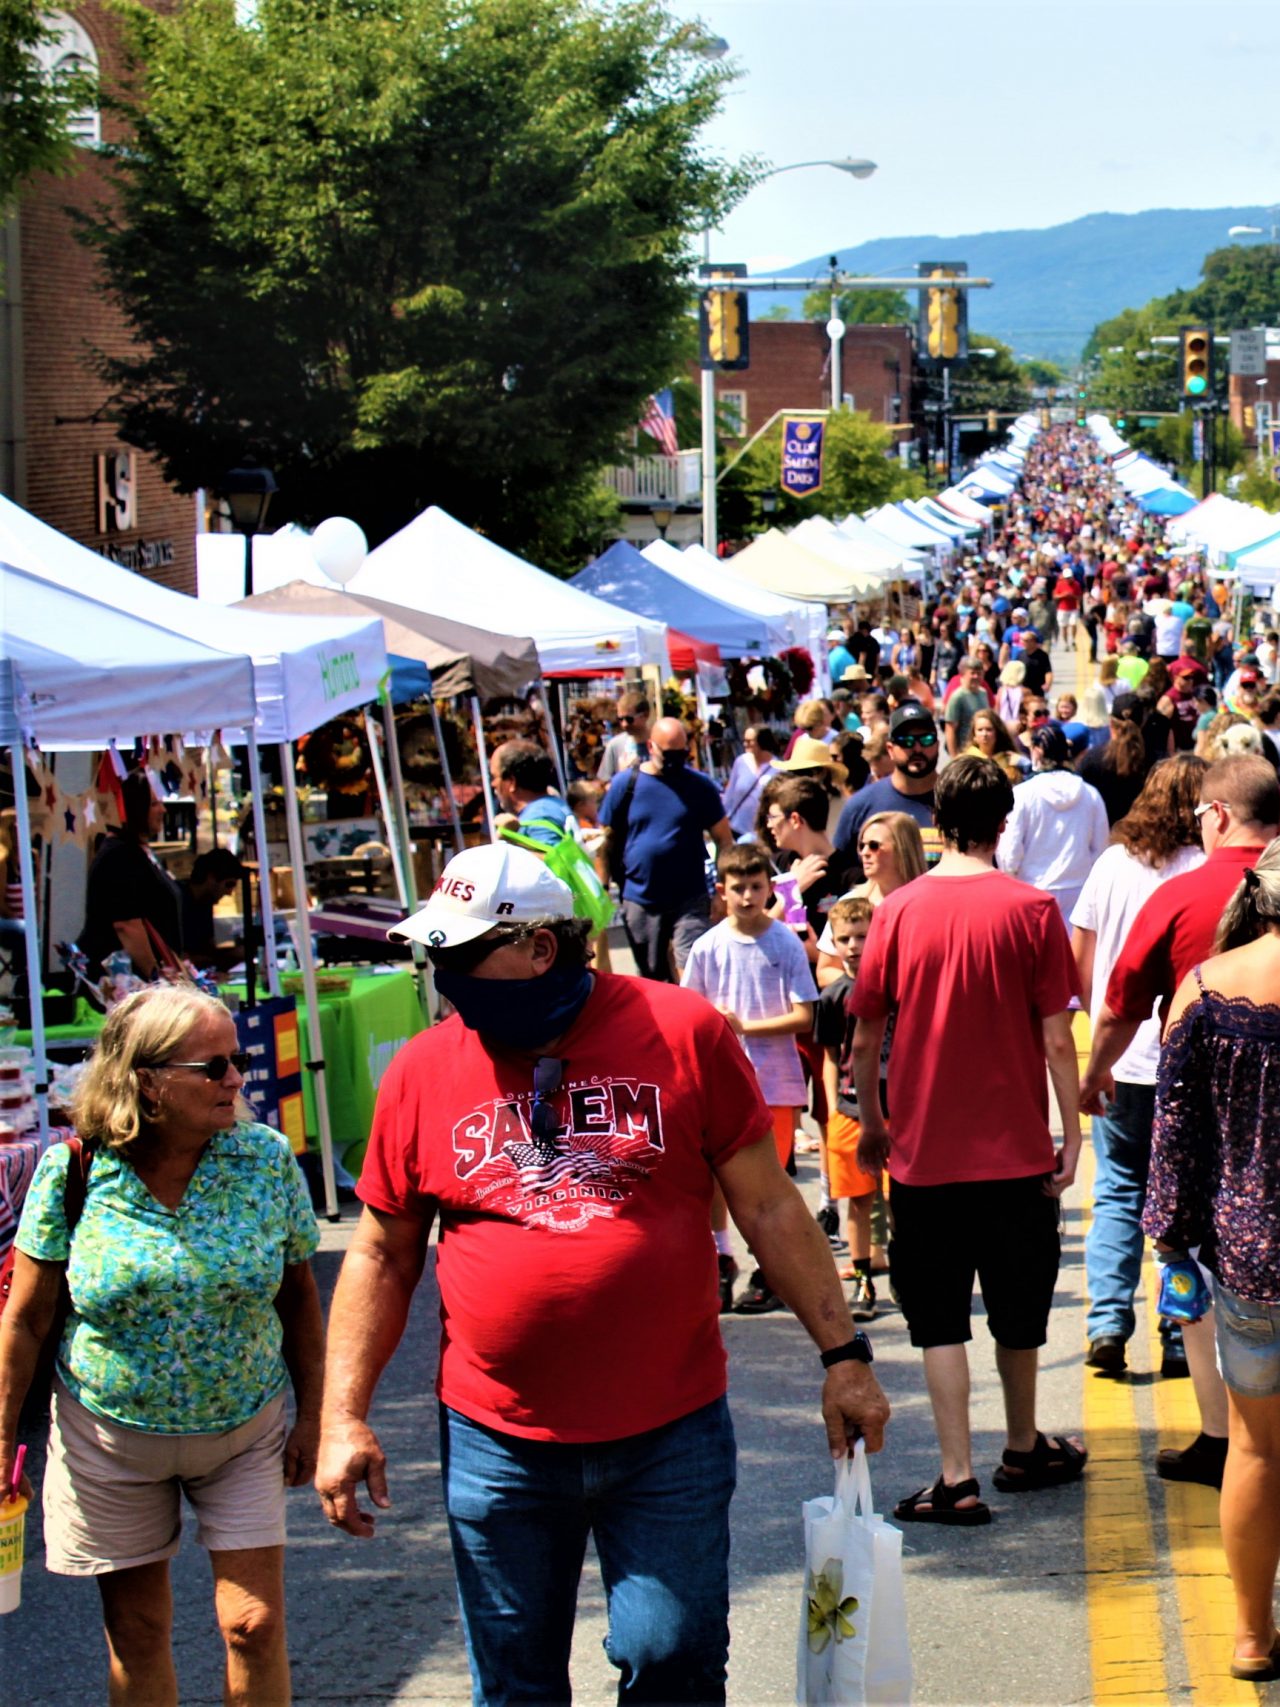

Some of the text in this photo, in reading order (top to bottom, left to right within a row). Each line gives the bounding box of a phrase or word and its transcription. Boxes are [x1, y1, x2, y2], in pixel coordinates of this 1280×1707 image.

[1239, 333, 1257, 343] NO
[787, 440, 817, 454] OLDE
[784, 455, 817, 468] SALEM
[786, 470, 813, 484] DAYS
[496, 902, 515, 915] R
[517, 1080, 588, 1100] GEINE
[506, 1186, 625, 1216] VIRGINIA
